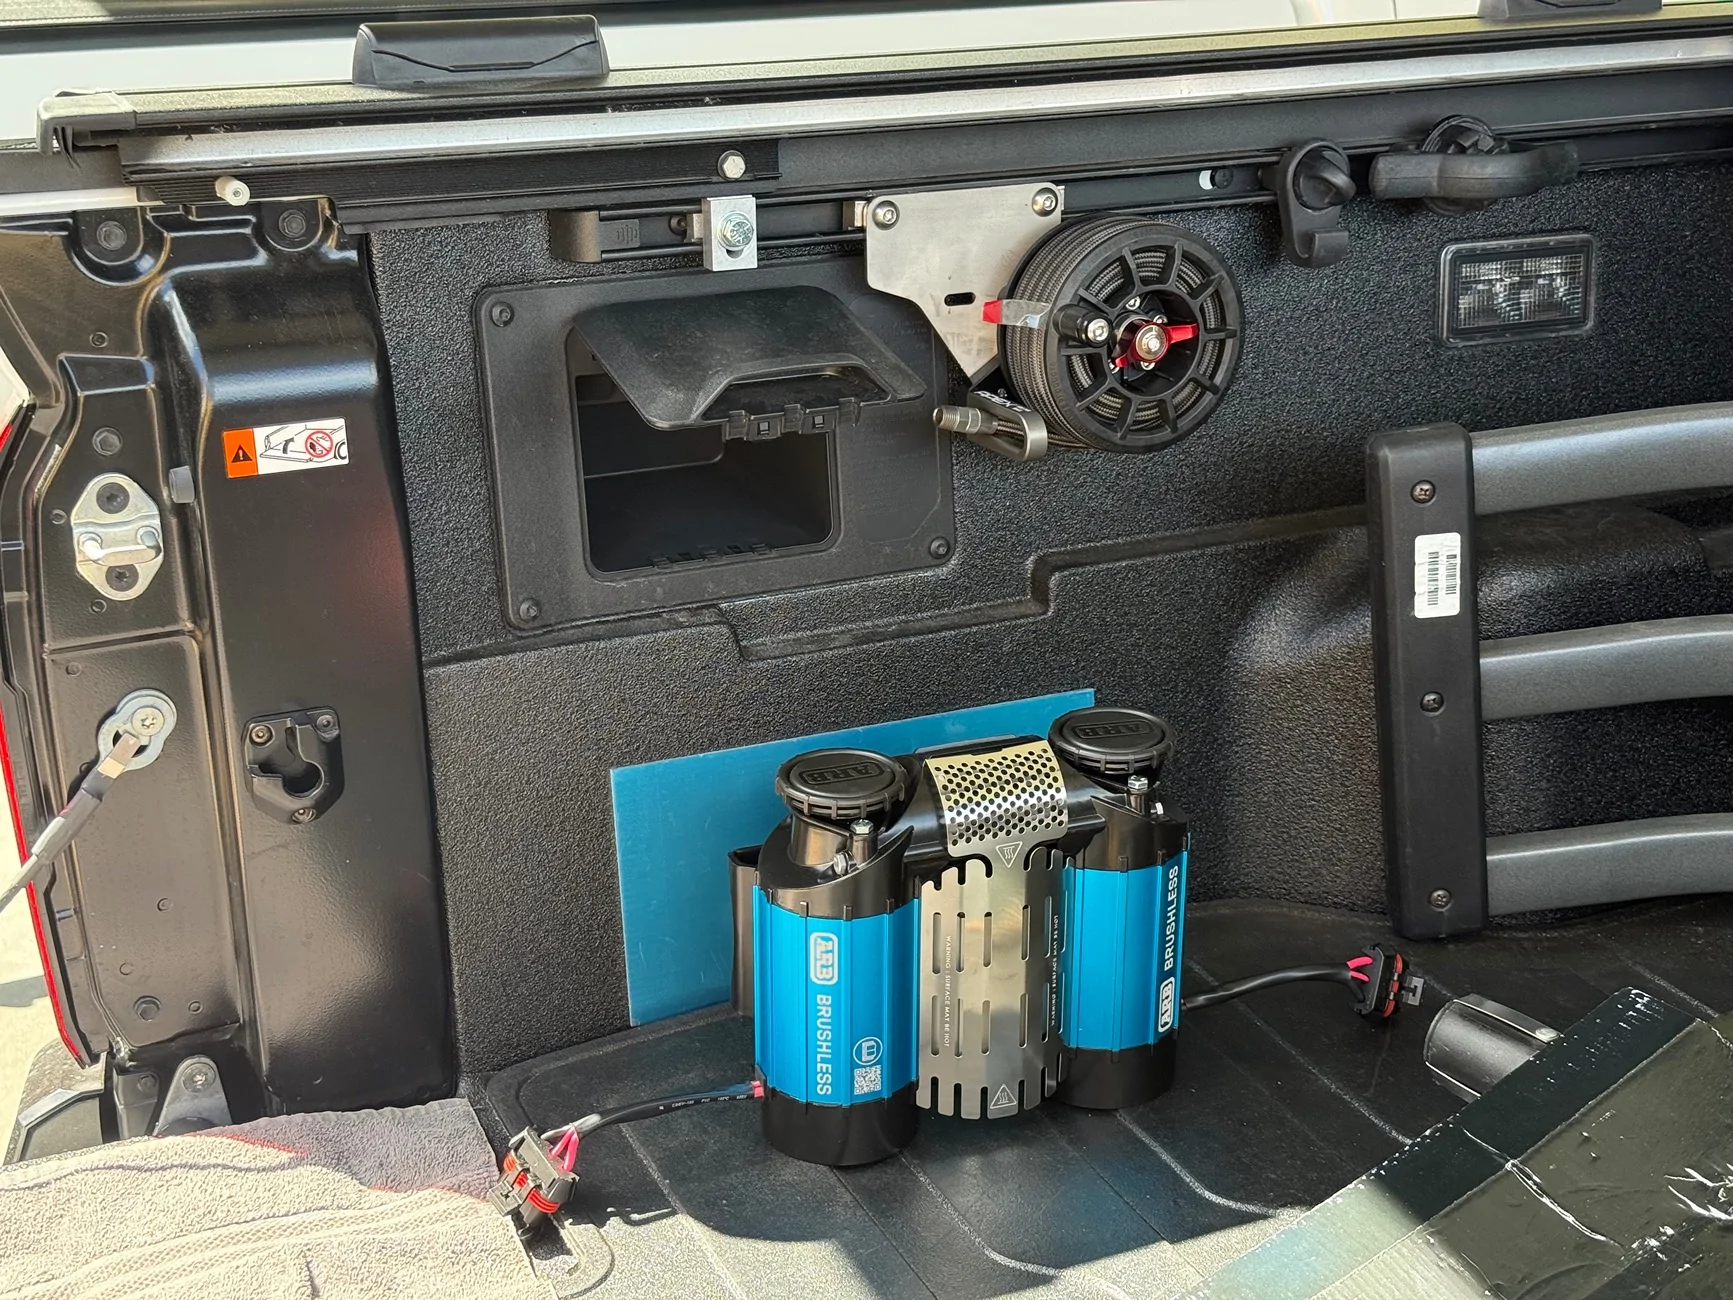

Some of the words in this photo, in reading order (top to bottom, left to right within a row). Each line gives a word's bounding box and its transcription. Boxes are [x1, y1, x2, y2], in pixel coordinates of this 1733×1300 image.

[1078, 721, 1148, 738] ARB
[804, 763, 877, 782] ARB
[1164, 865, 1179, 971] BRUSHLESS
[813, 934, 835, 982] ARB
[944, 1023, 950, 1032] BE
[1159, 980, 1174, 1030] ARB
[816, 994, 832, 1095] BRUSHLESS
